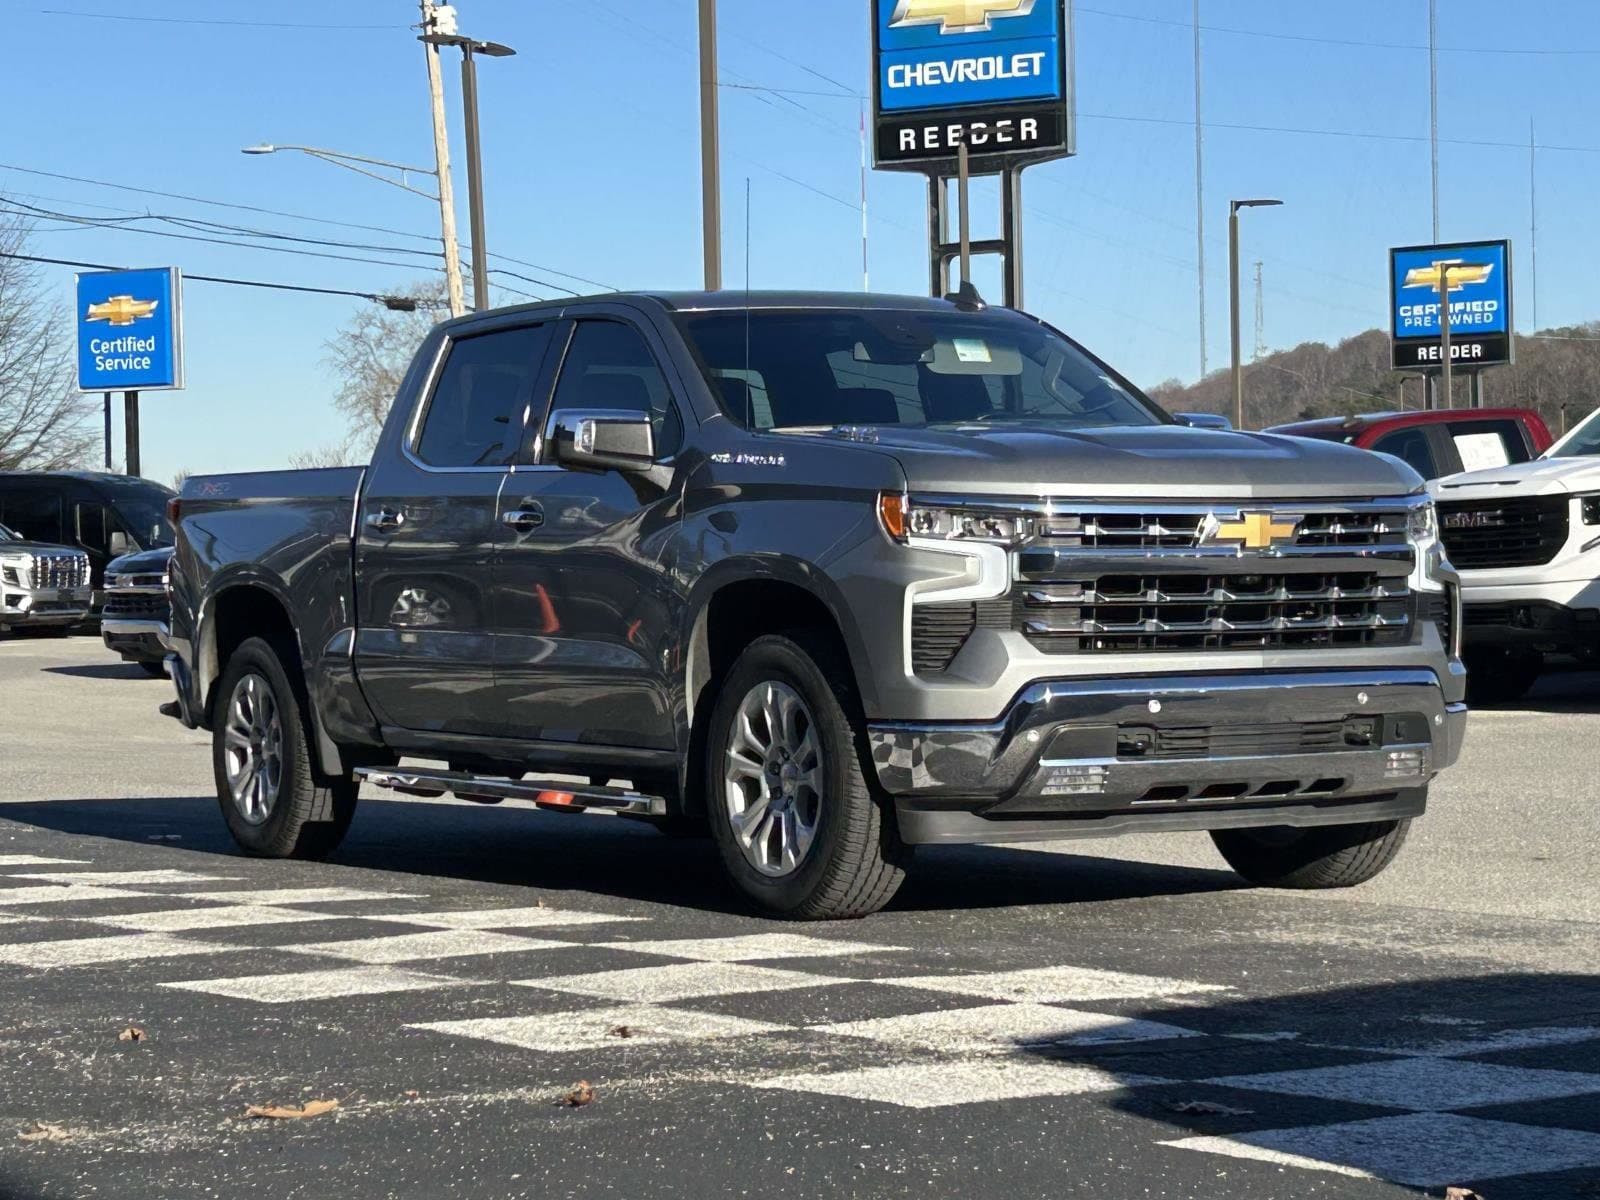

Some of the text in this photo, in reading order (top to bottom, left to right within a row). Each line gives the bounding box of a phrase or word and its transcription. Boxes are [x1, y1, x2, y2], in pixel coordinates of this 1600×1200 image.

[888, 52, 1045, 88] CHEVROLET
[899, 118, 1038, 151] REEDER
[1399, 300, 1498, 317] CERIFIED
[90, 335, 155, 354] Certified
[95, 354, 151, 371] Service
